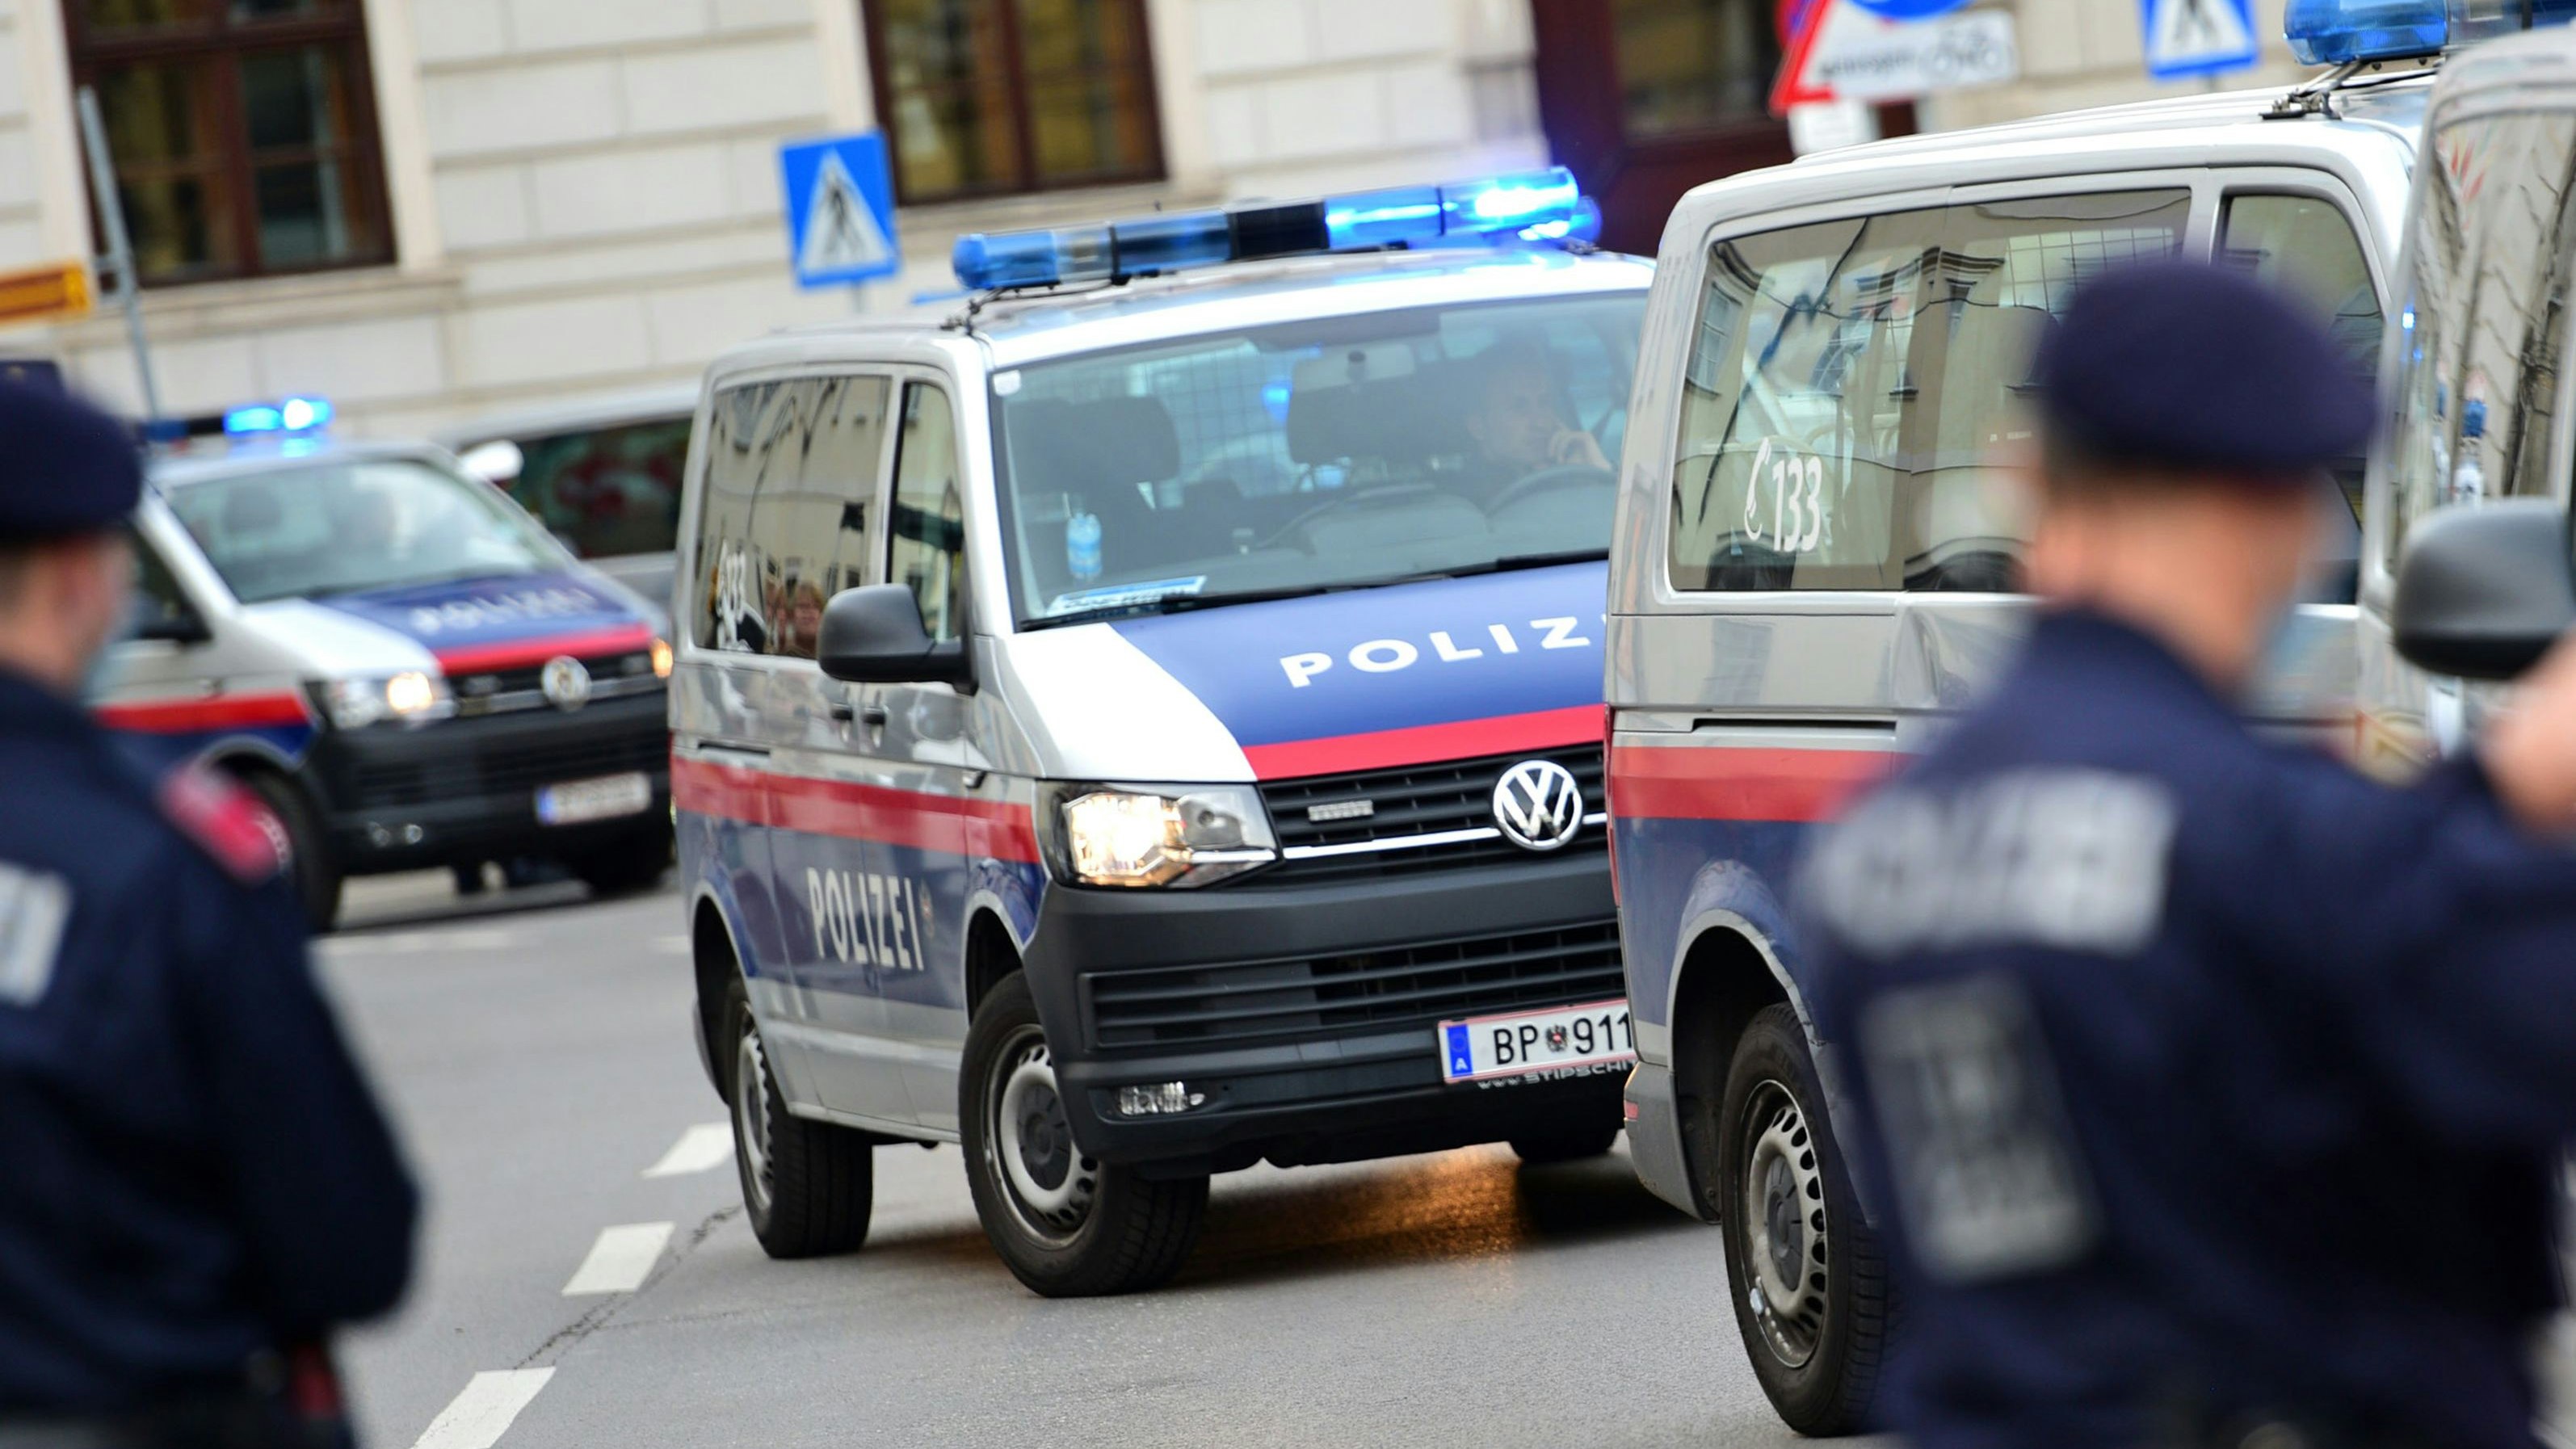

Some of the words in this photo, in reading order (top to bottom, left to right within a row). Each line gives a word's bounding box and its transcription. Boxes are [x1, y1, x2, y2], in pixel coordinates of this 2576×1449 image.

[1772, 456, 1822, 552] 133
[1280, 614, 1606, 688] POLIZ
[1494, 759, 1582, 850] VW
[807, 867, 924, 971] POLIZEI
[1455, 1057, 1469, 1071] A
[1494, 1024, 1538, 1065] BP
[1573, 1012, 1632, 1054] 911
